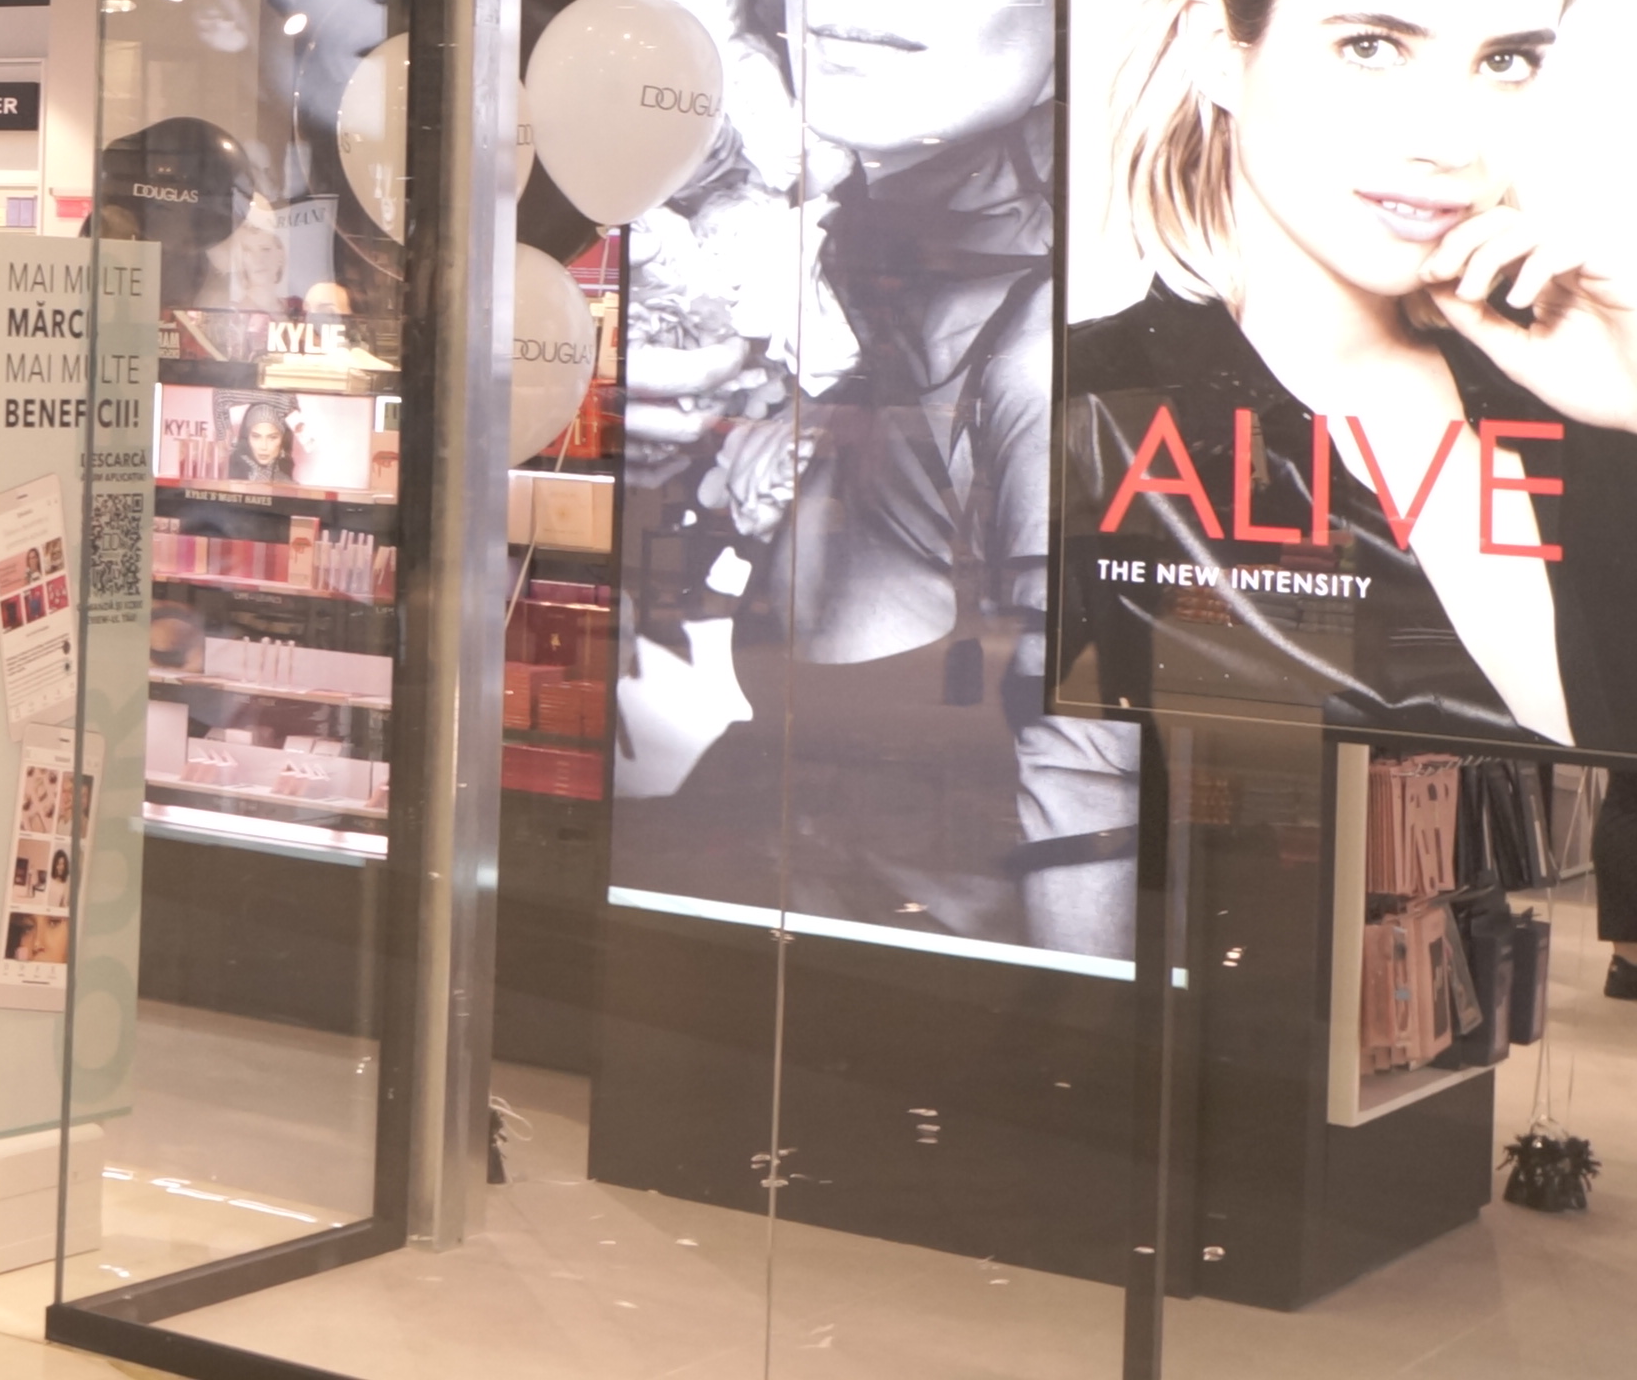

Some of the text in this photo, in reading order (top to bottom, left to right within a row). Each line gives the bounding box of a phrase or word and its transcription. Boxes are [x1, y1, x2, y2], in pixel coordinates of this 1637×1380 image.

[132, 183, 199, 203] DOUGLAS
[8, 262, 54, 292] MAI
[267, 322, 346, 354] KYLIE
[5, 353, 52, 383] MAI
[5, 398, 140, 429] BENEFCII!
[1099, 405, 1564, 562] ALIVE
[1098, 559, 1372, 599] THE NEW INTENSITY
